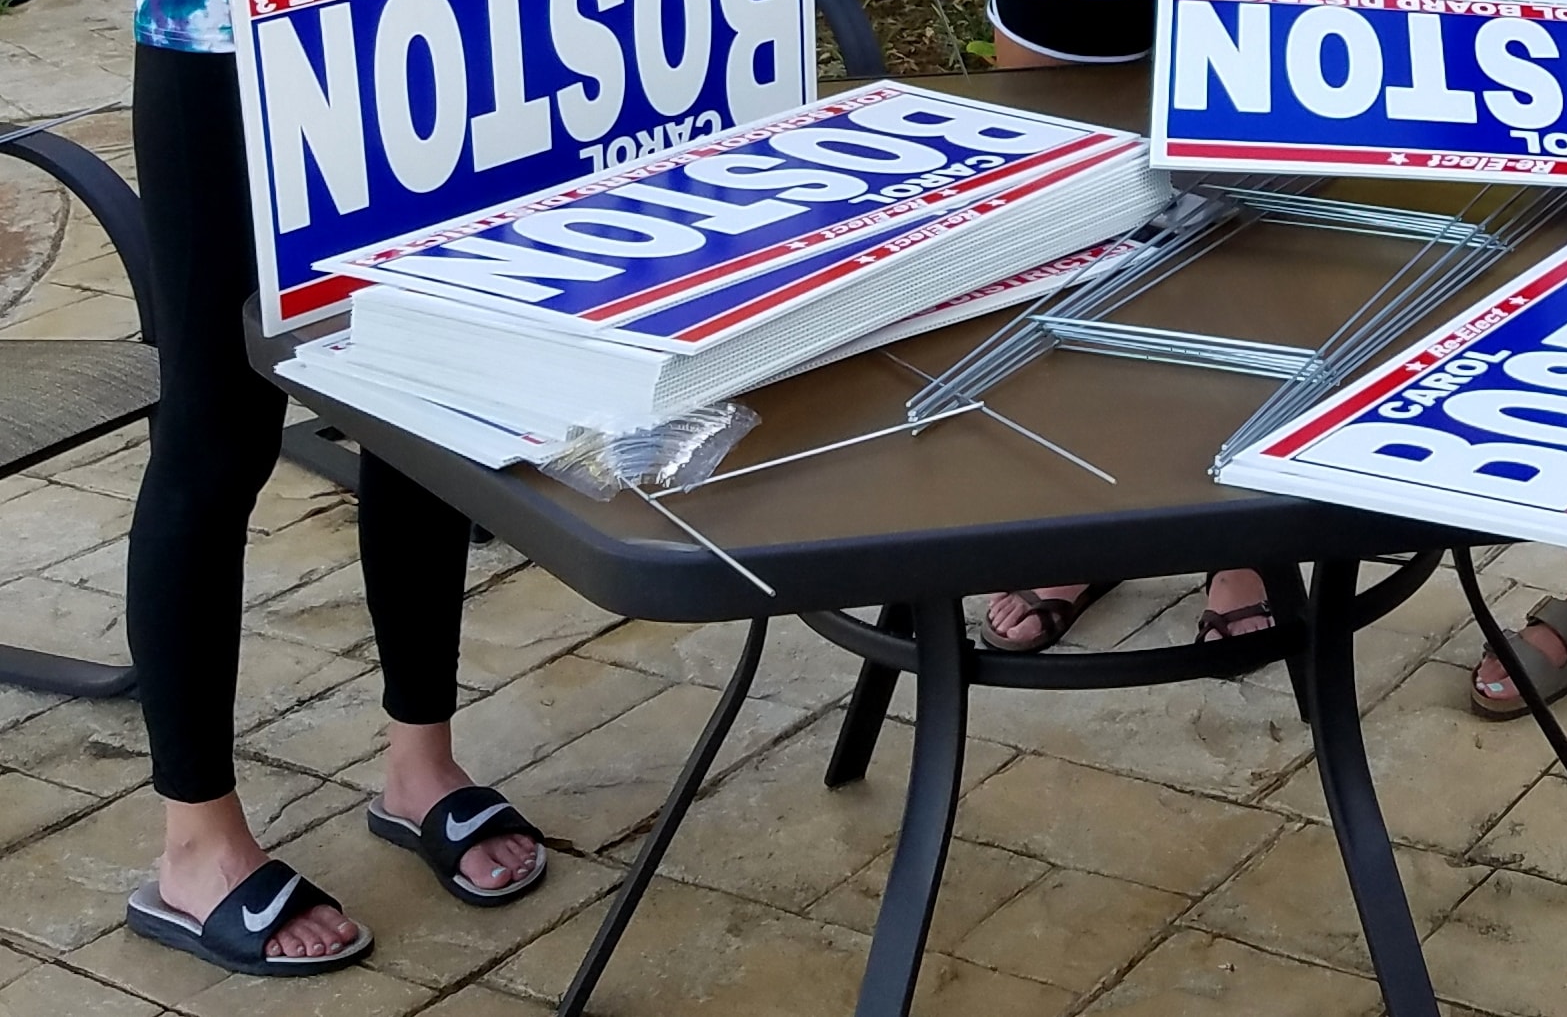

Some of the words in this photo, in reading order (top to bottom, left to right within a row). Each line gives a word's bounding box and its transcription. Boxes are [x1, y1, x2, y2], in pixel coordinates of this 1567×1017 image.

[843, 88, 896, 111] FOR
[580, 109, 722, 173] CAROL
[704, 104, 838, 157] SCHOOL
[848, 154, 1007, 205] CAROL
[1426, 153, 1556, 175] Re-Elect
[376, 93, 1088, 304] BOSTON
[1425, 306, 1508, 361] Re-Elect
[1376, 347, 1512, 420] CAROL
